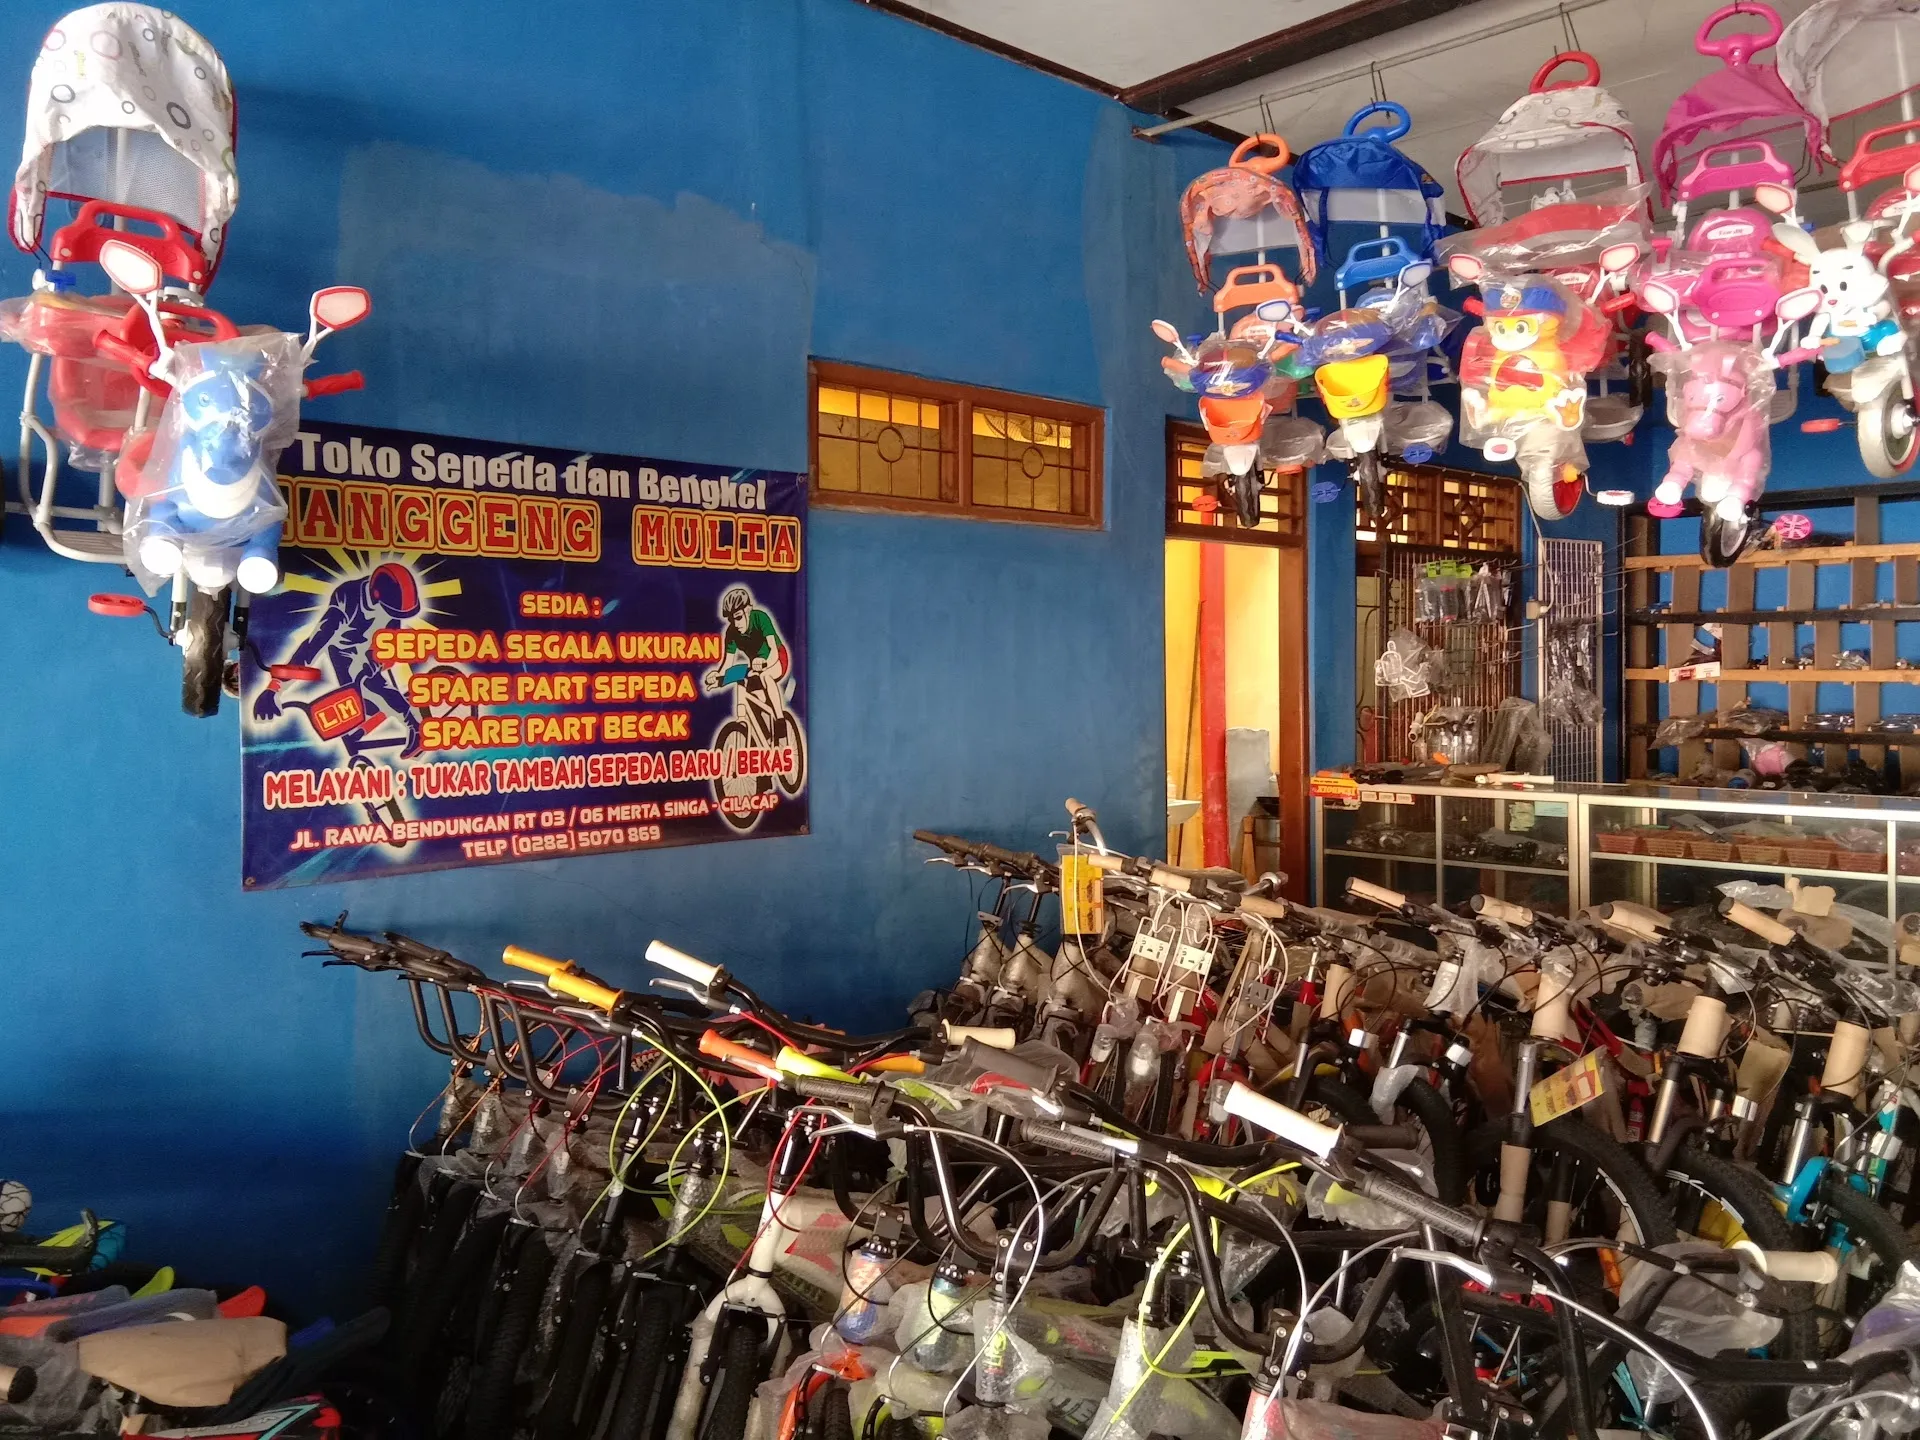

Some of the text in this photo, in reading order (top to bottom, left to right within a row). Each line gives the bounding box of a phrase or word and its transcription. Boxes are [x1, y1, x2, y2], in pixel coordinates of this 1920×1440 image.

[295, 432, 767, 511] Toko Sepeda dan Bengkel
[279, 482, 797, 567] ANGGENG MULIA
[523, 595, 588, 615] SEDIA
[375, 633, 720, 660] SEPEDA SEGALA UKURAN
[411, 675, 695, 703] SPARE PART SEPEDA
[422, 714, 688, 747] SPARE PART BECAK
[265, 768, 392, 807] MELAYANI
[411, 764, 490, 796] TUKAR
[495, 757, 584, 793] TAMBAH
[589, 754, 667, 784] SEPEDA
[672, 750, 722, 780] BARU
[737, 748, 793, 776] BEKAS
[290, 831, 320, 850] JL.
[326, 826, 388, 846] RAWA
[392, 813, 510, 841] BENDUNGAN
[514, 812, 537, 830] RT
[541, 810, 565, 827] 03
[580, 808, 604, 823] 06
[607, 803, 660, 821] MERTA
[664, 799, 709, 817] SINGA
[721, 794, 779, 813] CILACAP
[462, 841, 507, 859] TELP
[579, 829, 624, 848] 5070
[628, 826, 661, 843] 869
